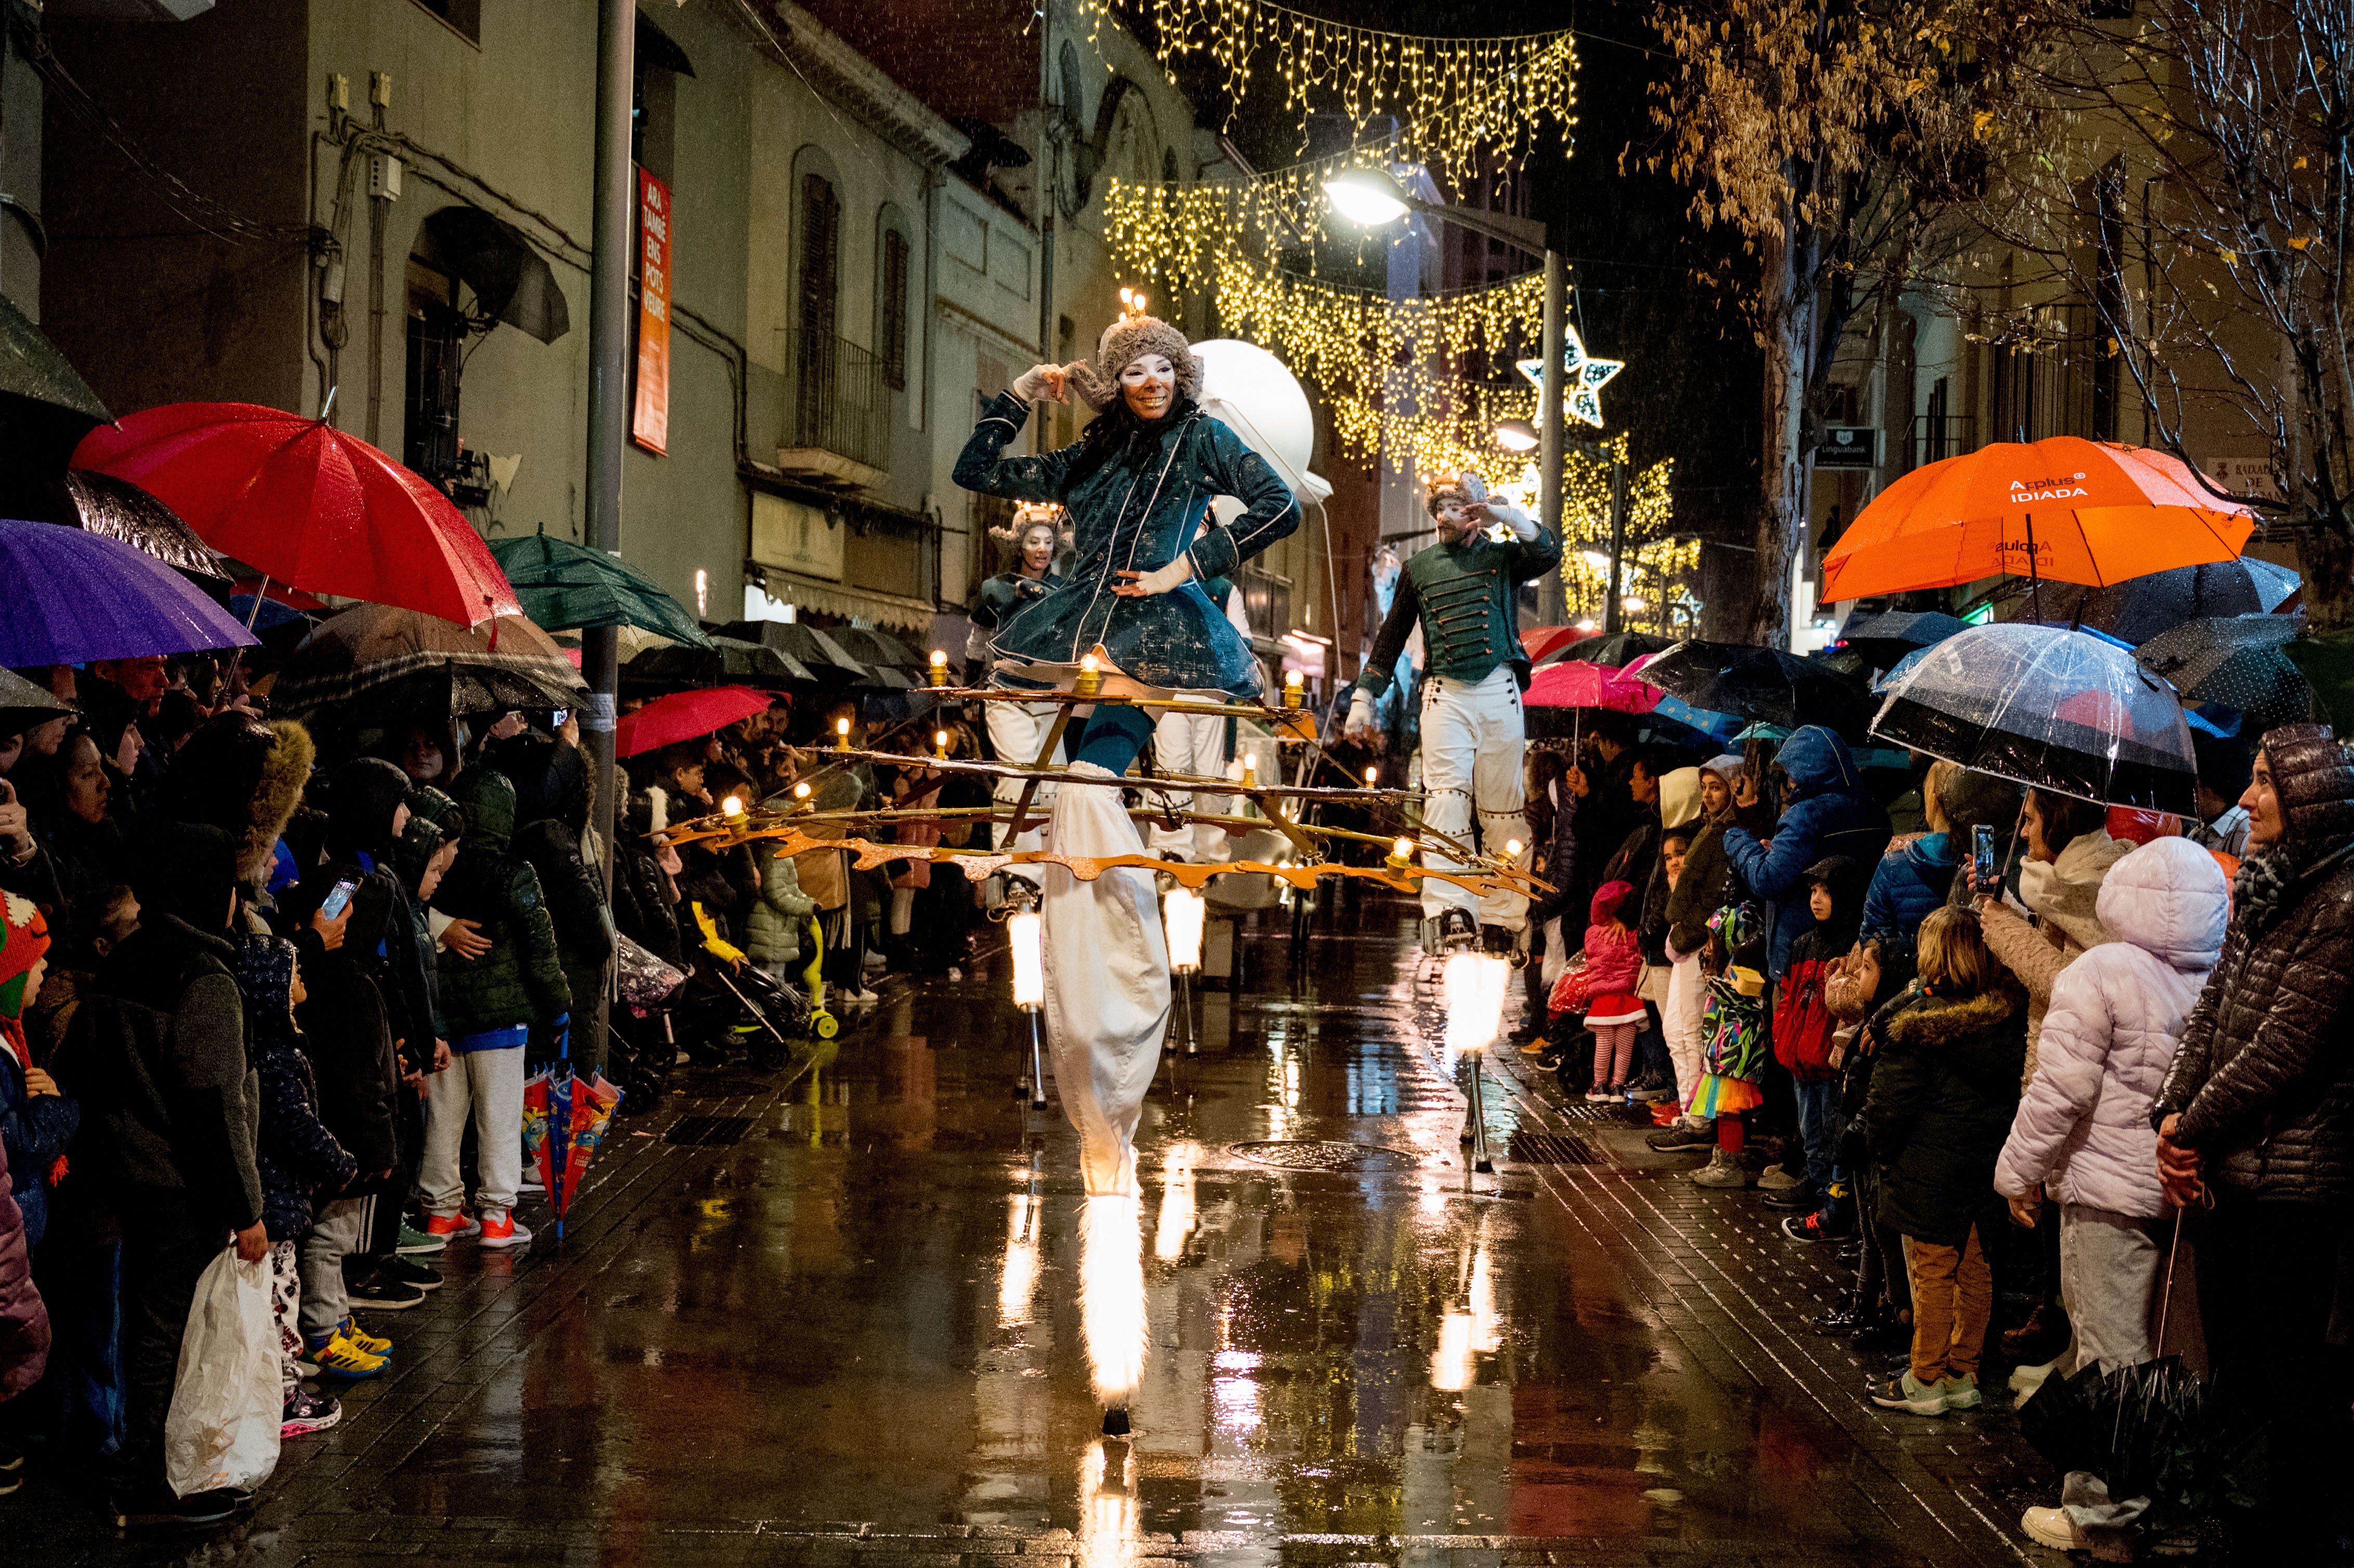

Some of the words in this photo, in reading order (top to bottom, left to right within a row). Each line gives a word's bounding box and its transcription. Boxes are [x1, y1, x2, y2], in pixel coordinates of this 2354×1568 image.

[647, 183, 662, 213] ARA
[647, 236, 661, 265] ENS
[645, 262, 663, 295] POTS
[644, 288, 665, 322] VEURE
[1822, 446, 1866, 455] Linguabank
[2235, 464, 2271, 475] BAIXAD
[2245, 477, 2263, 487] DE
[2011, 488, 2088, 503] IDIADA
